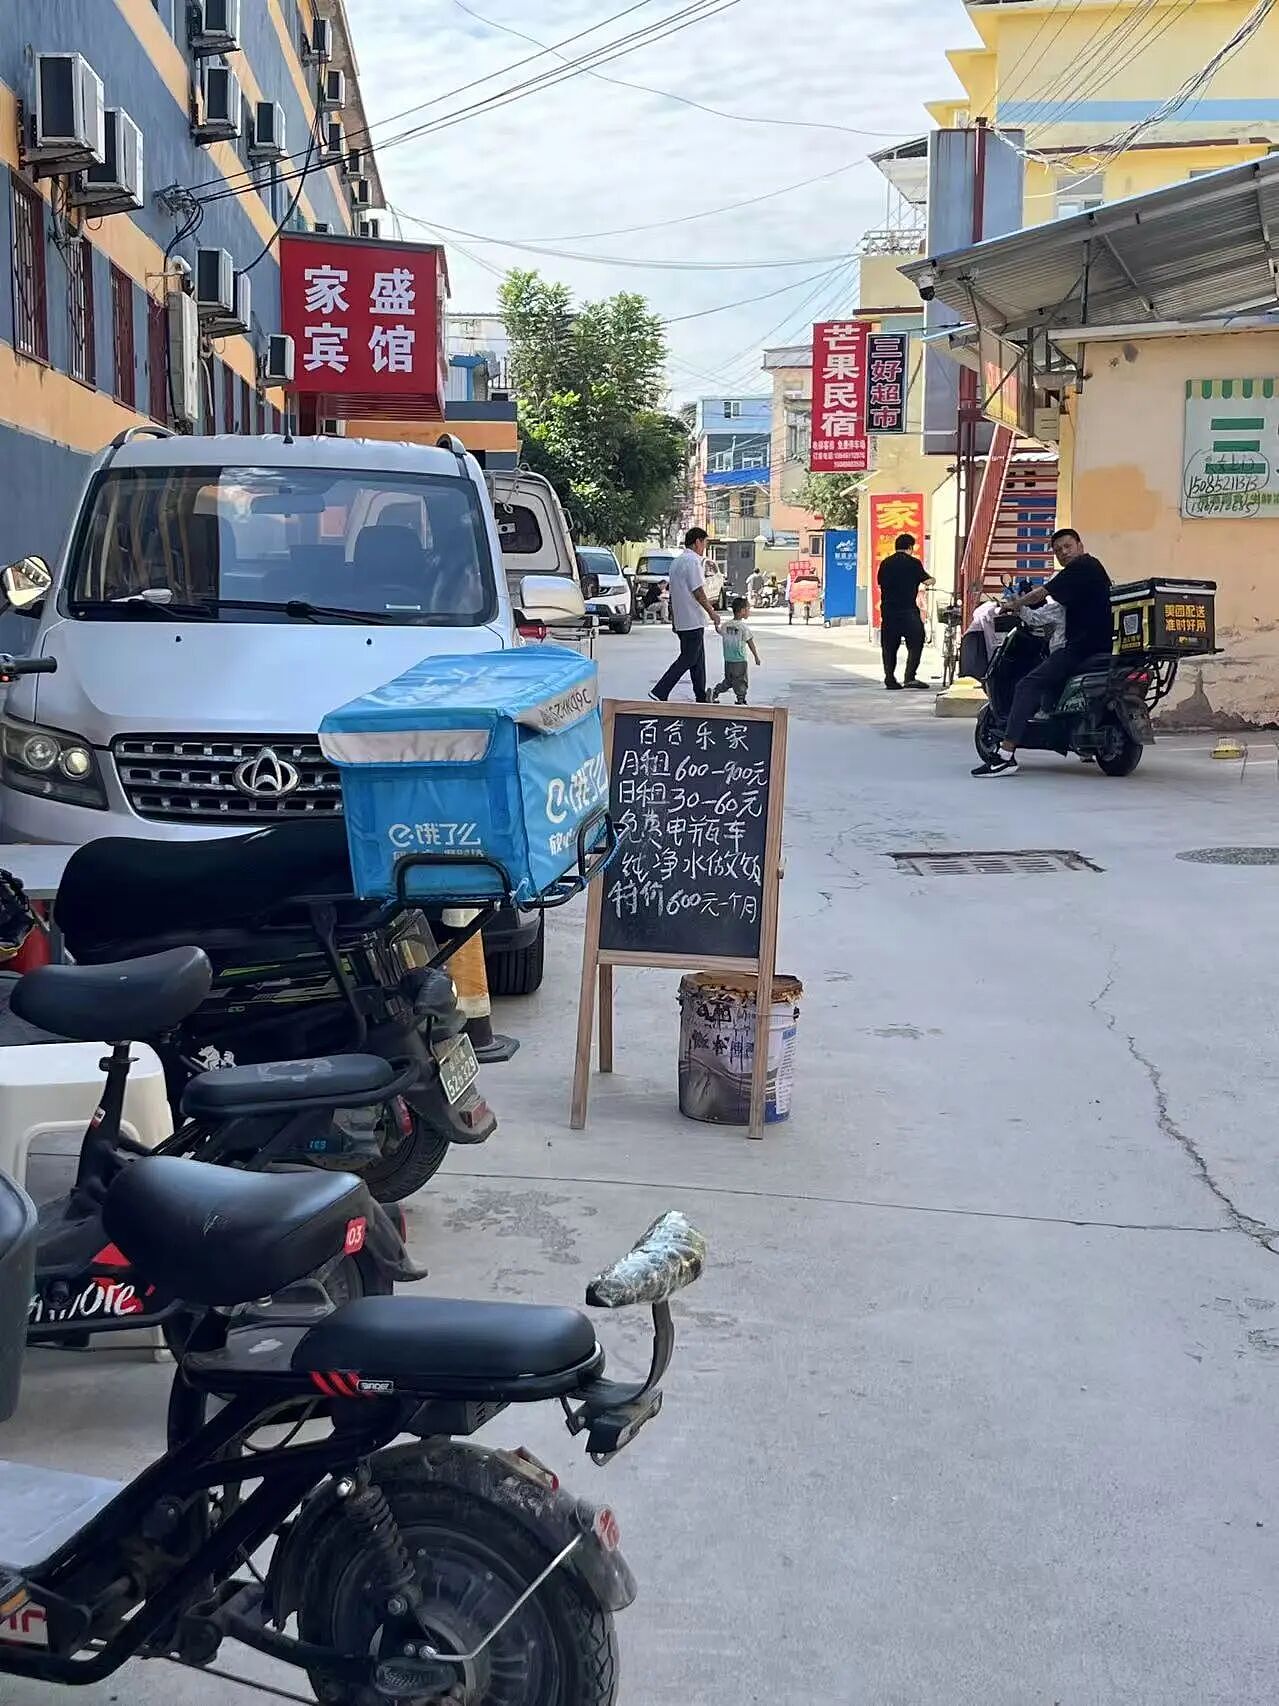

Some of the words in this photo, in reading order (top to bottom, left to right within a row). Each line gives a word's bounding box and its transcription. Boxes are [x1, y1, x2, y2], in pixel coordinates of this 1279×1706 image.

[303, 264, 416, 316] 家盛
[303, 322, 416, 374] 宾馆
[820, 325, 858, 437] 芒果民宿
[870, 337, 903, 428] 三好超市
[639, 719, 750, 752] 百合乐家
[617, 808, 747, 853] 免费电瓶车
[621, 847, 762, 887] 纯净水做饭
